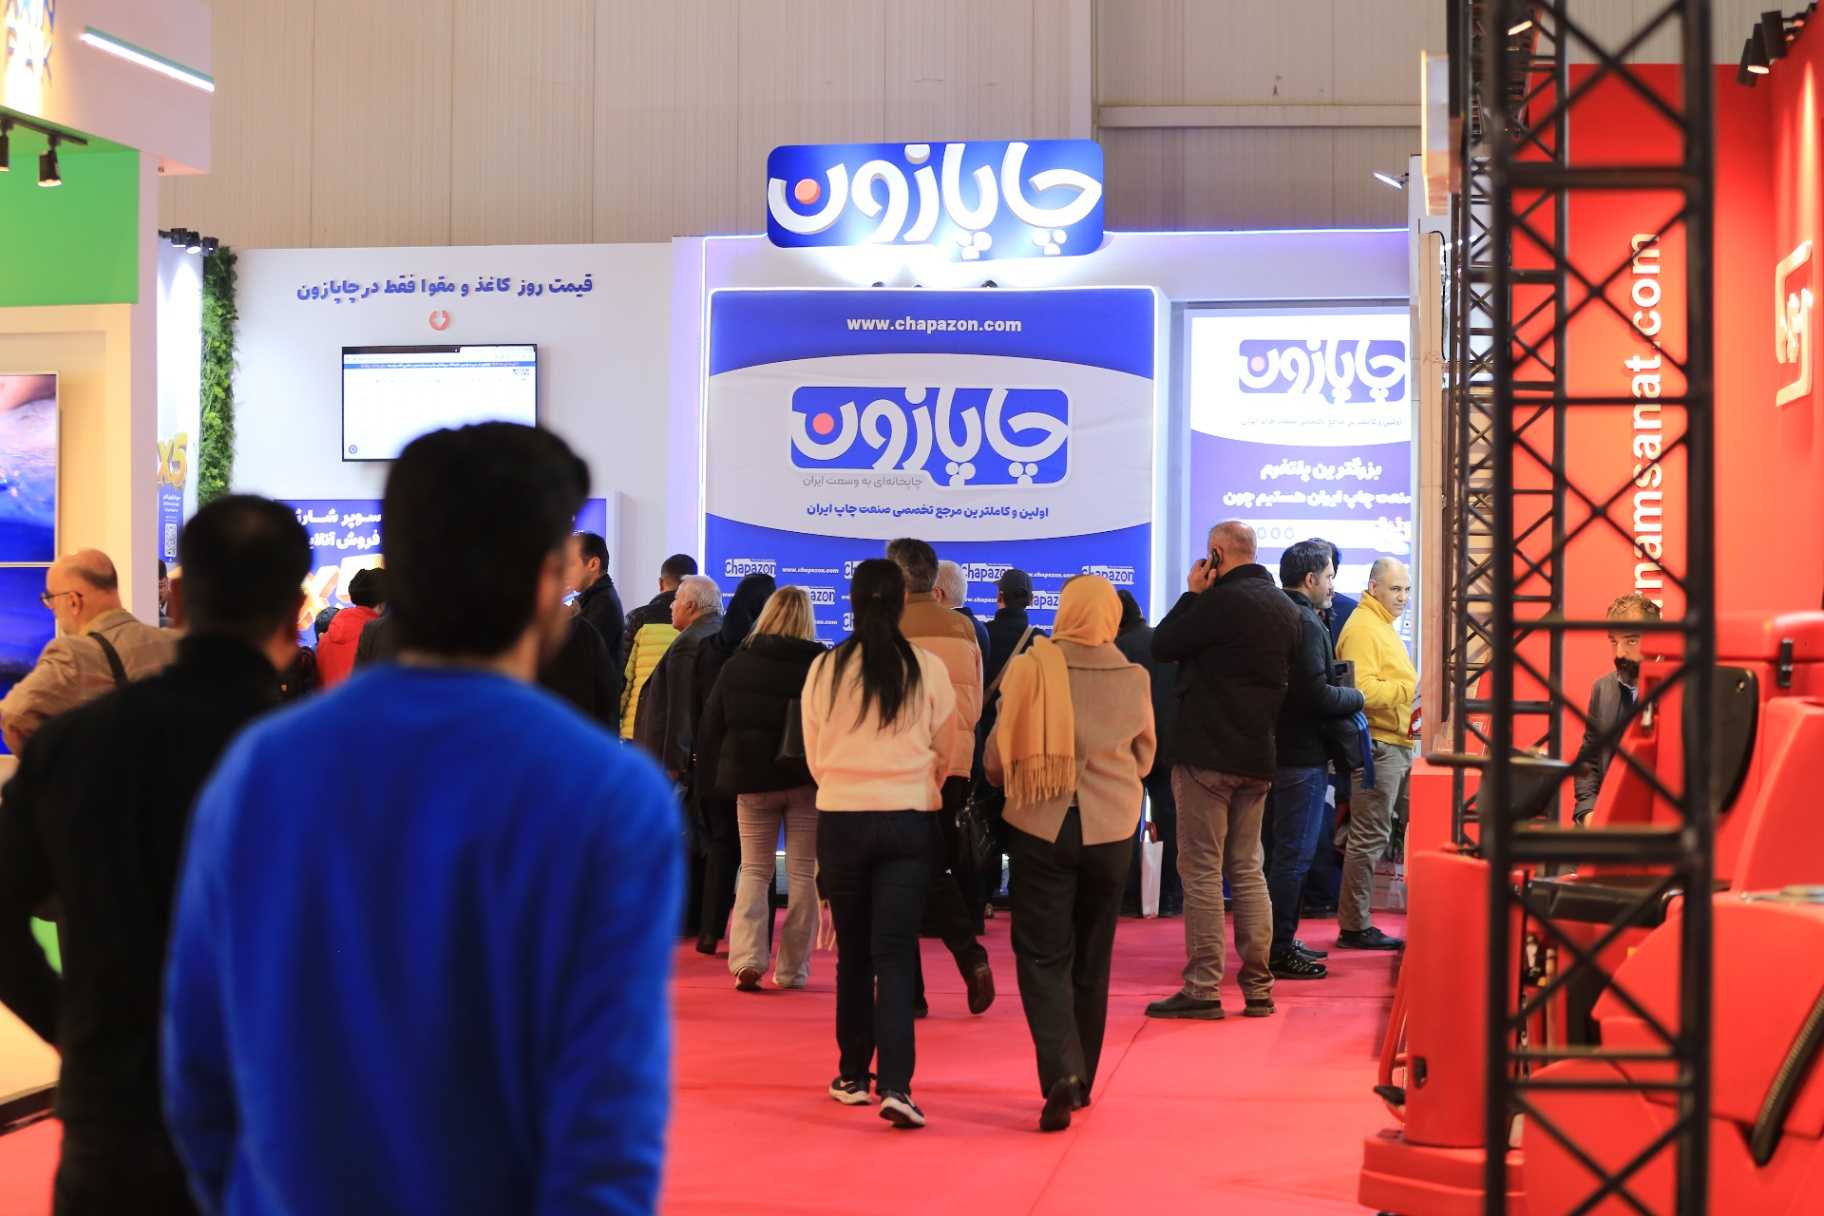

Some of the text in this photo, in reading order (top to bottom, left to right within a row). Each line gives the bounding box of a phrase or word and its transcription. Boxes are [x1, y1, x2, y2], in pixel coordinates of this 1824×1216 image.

[768, 142, 1103, 260] چاپازون
[296, 273, 593, 304] قیمت روز کاغذ و مقوا فقط در چاپازون
[847, 316, 1023, 334] www.chapazon.com
[1239, 339, 1407, 405] چاپازون
[1624, 233, 1664, 619] namsanat.com
[791, 387, 1071, 486] چاپازون
[1259, 457, 1383, 482] بزرگترین پلتفرم
[802, 474, 825, 488] ایران
[826, 476, 860, 489] وسعت
[861, 477, 872, 488] به
[1222, 490, 1256, 509] چون
[1255, 490, 1307, 508] هستیم
[1307, 490, 1343, 508] ایران
[1343, 490, 1376, 509] چاپ
[806, 503, 1049, 520] اولین و کاملترین مرجع تخصصی صنعت چاپ ایران
[335, 529, 381, 550] فروش
[725, 560, 776, 578] Chapazon
[810, 589, 835, 604] azon
